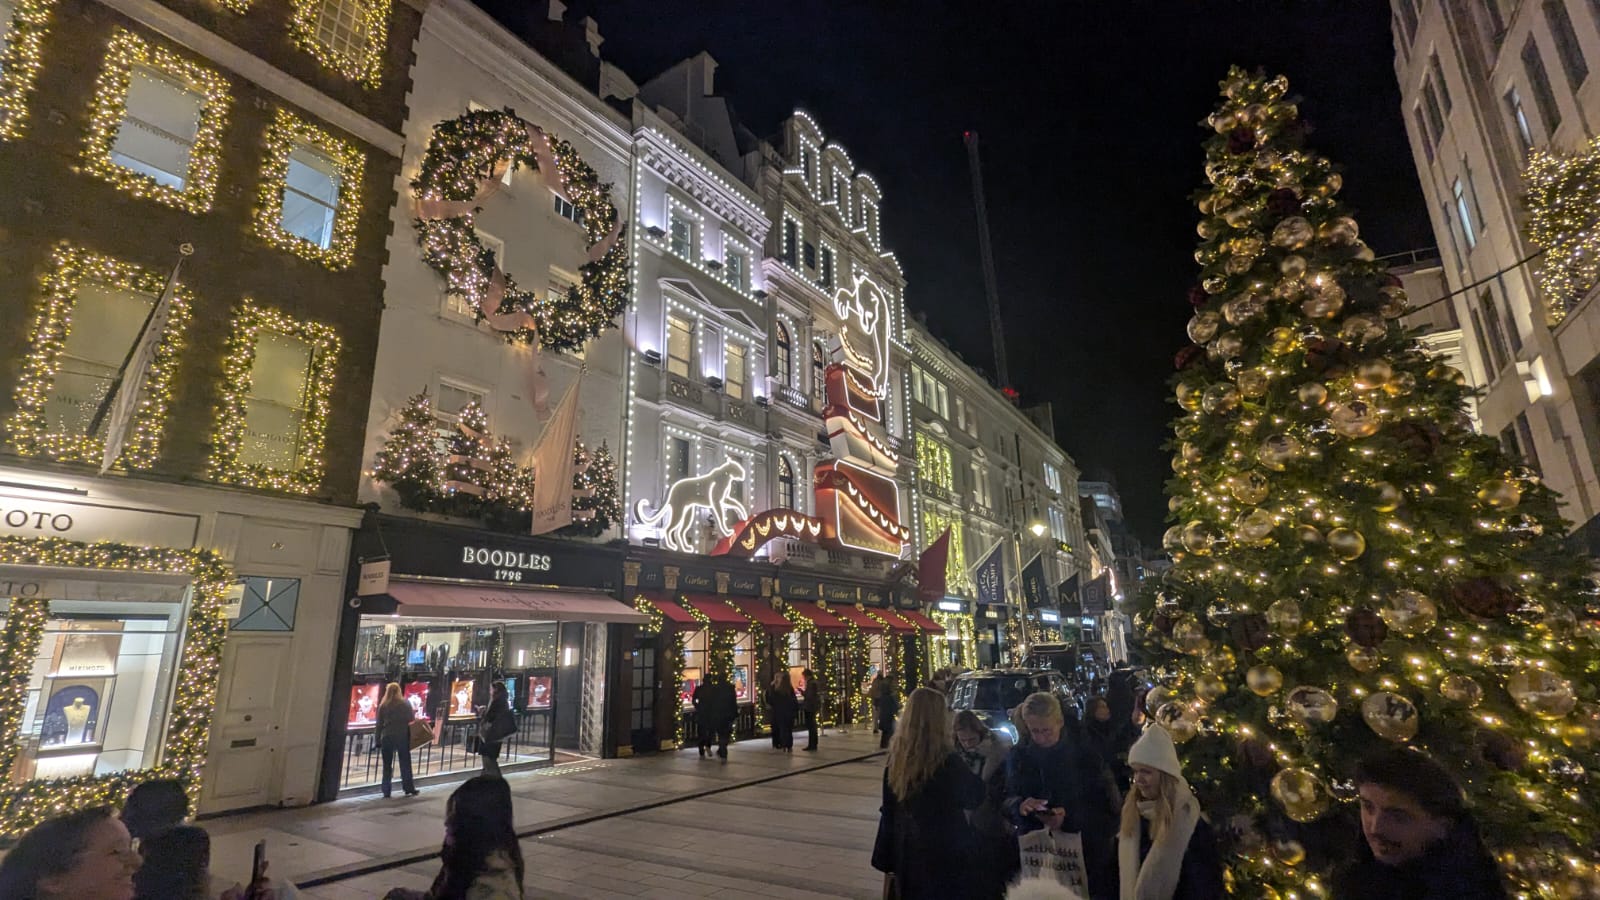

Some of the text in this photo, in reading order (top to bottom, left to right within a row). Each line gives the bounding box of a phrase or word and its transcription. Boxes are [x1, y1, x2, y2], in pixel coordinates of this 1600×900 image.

[462, 546, 551, 571] BOODLES
[495, 569, 522, 581] 1798
[684, 574, 709, 586] Cartier
